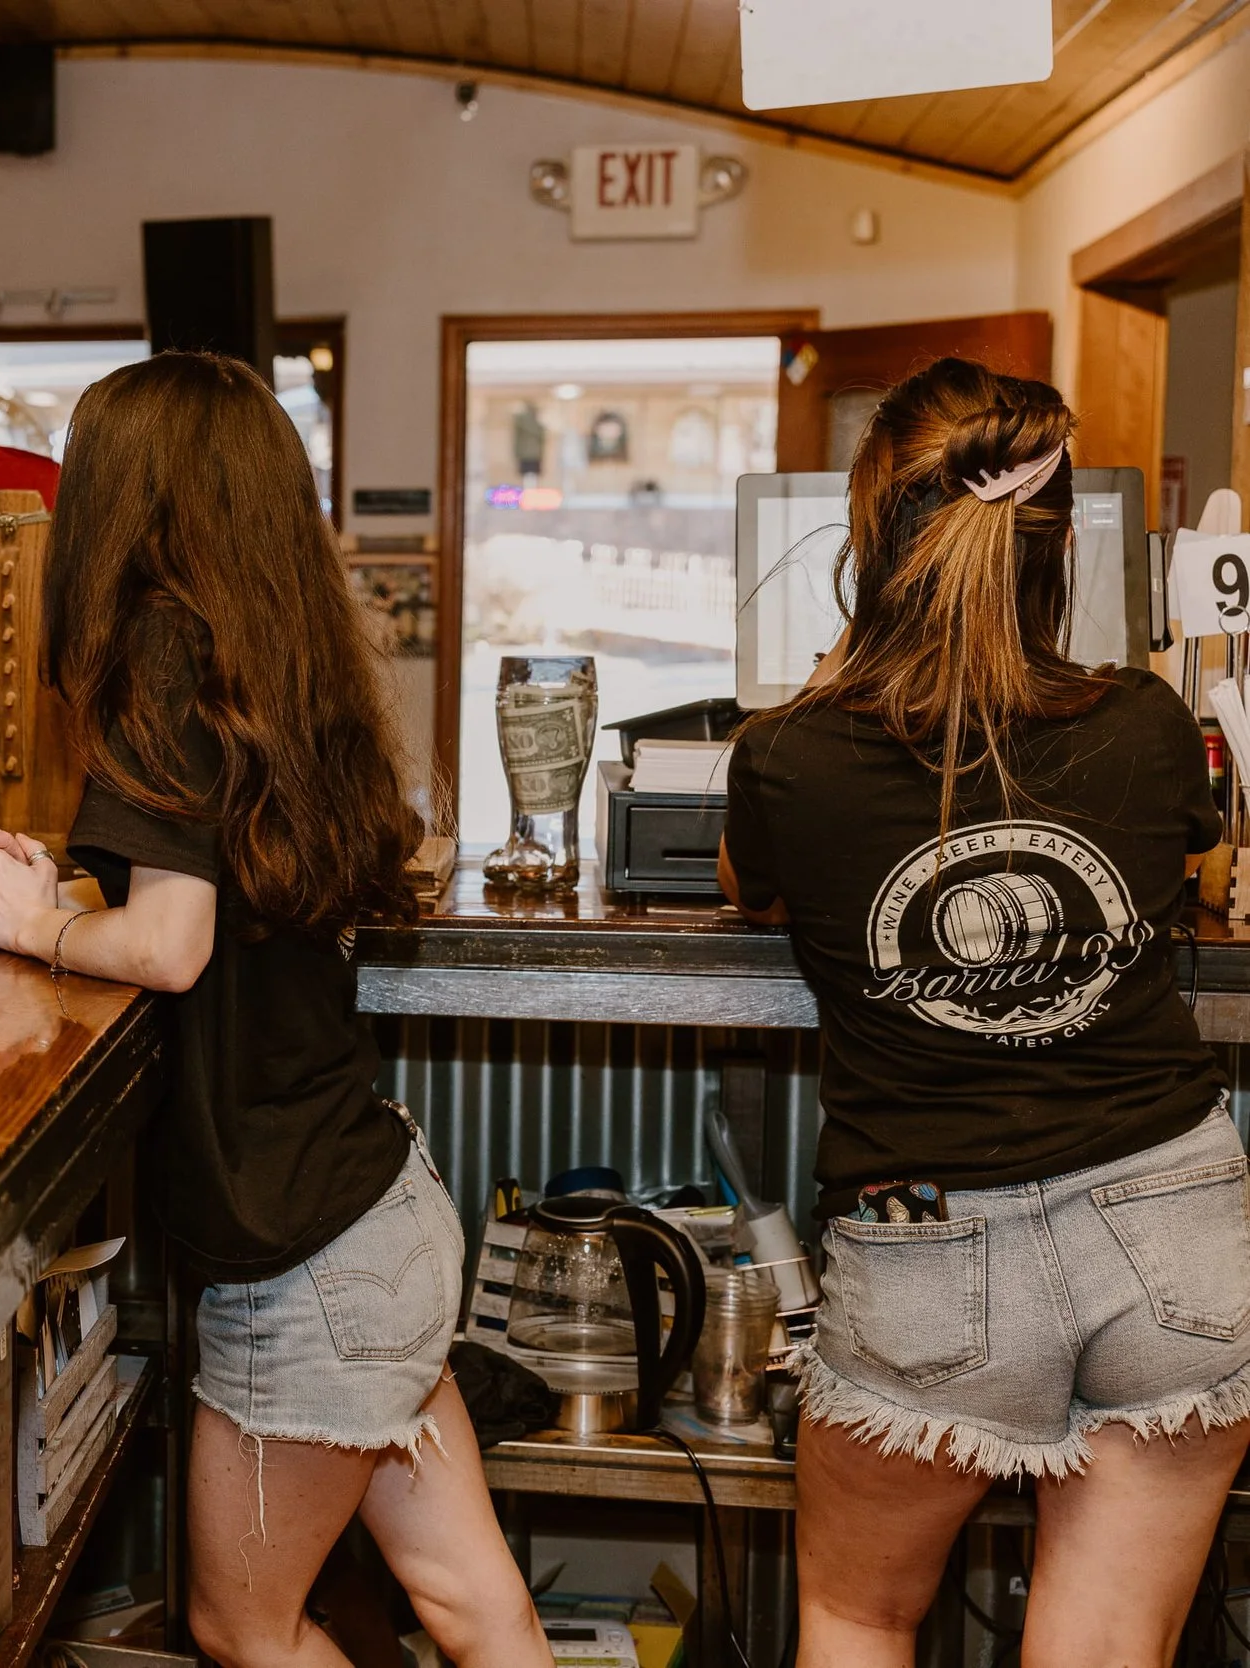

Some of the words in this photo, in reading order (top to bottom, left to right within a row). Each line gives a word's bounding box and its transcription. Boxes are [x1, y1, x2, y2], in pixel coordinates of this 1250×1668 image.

[597, 151, 678, 208] EXIT
[1212, 553, 1249, 617] 9
[883, 876, 917, 931] WINE
[935, 834, 997, 864] BEER
[1029, 833, 1109, 888] EATERY
[863, 934, 1068, 1001] Barrel
